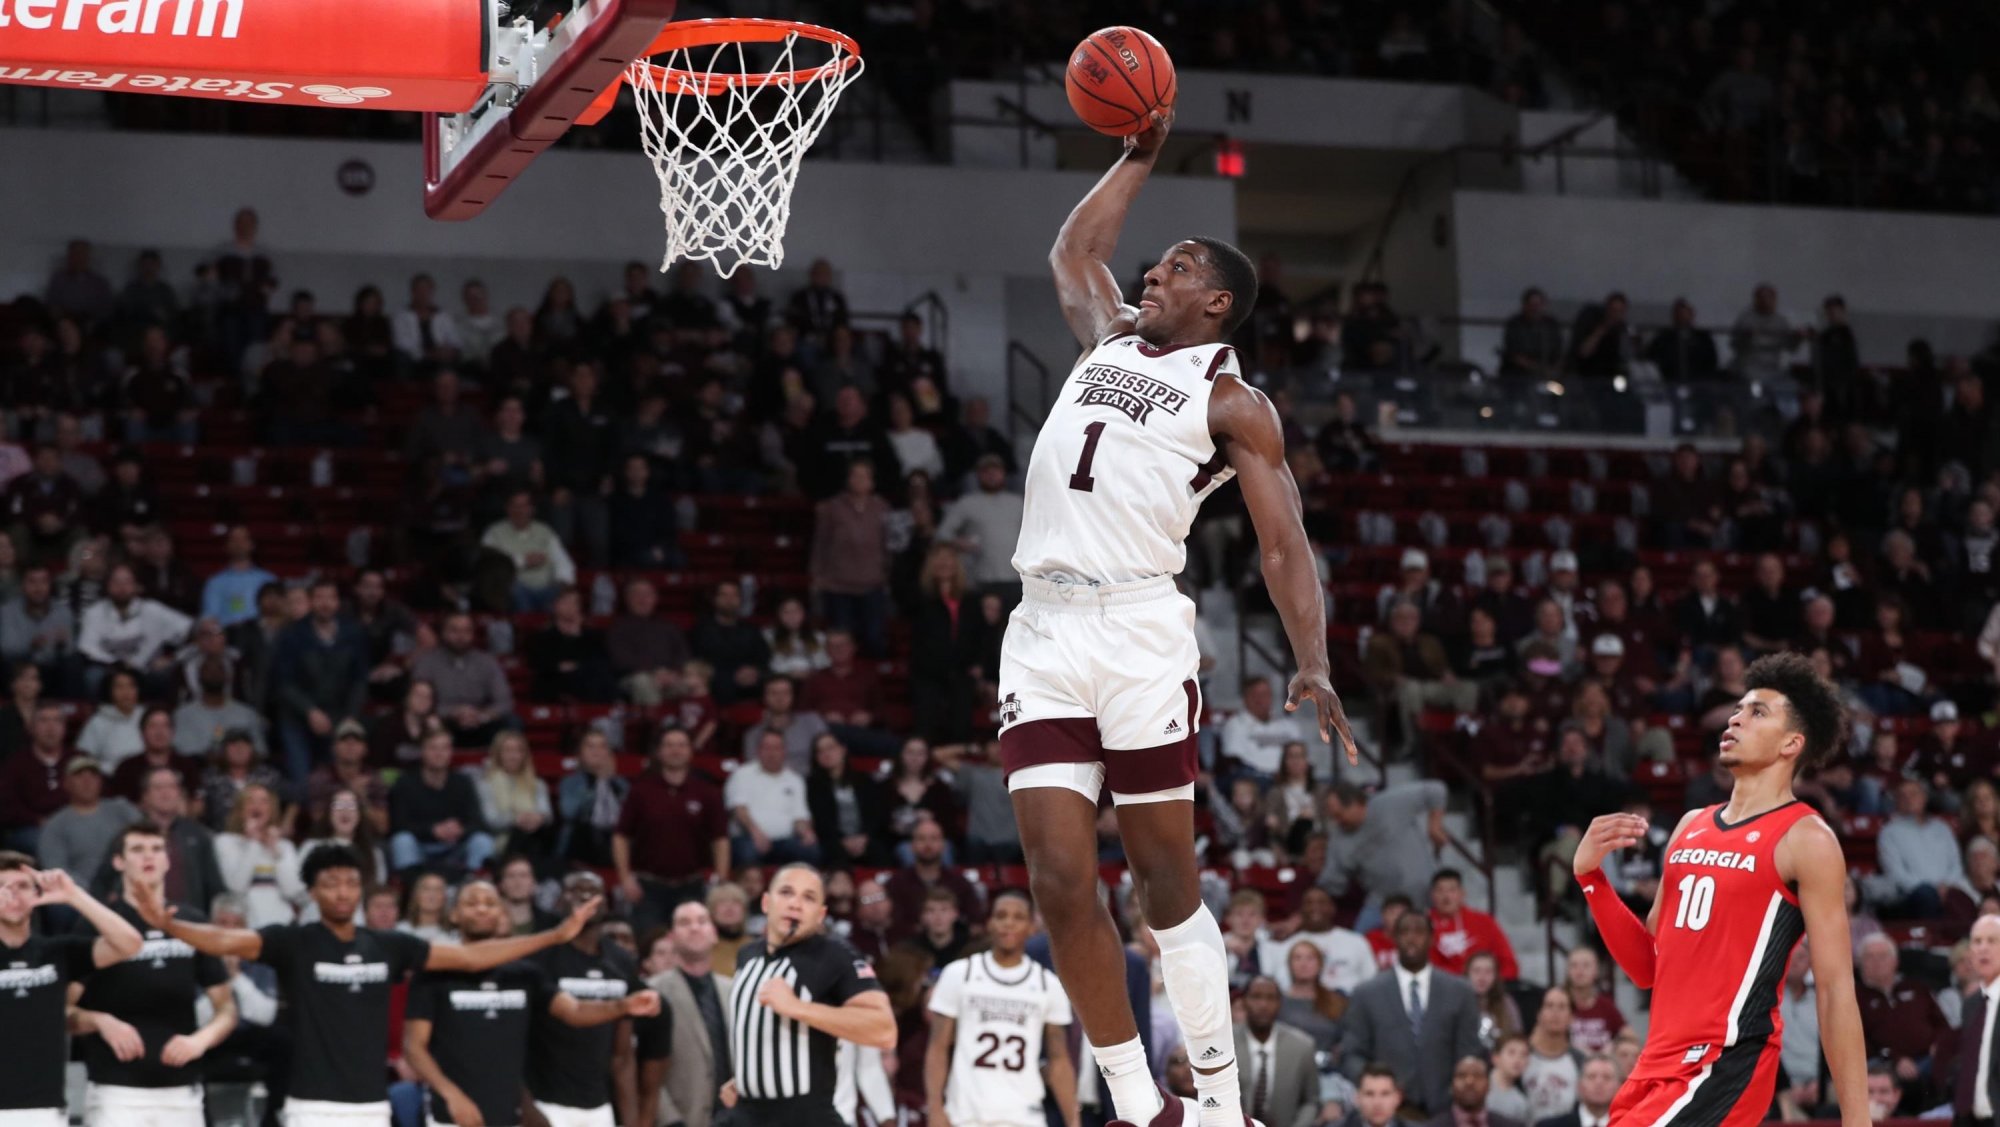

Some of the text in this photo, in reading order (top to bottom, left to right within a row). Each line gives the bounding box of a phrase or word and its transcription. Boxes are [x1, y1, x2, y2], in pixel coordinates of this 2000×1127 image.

[1078, 366, 1188, 412] MISSISSIPPI
[1088, 390, 1140, 415] STATE
[1069, 421, 1106, 492] 1
[1669, 848, 1756, 873] GEORGIA
[1674, 874, 1716, 931] 10
[974, 1032, 1027, 1073] 23
